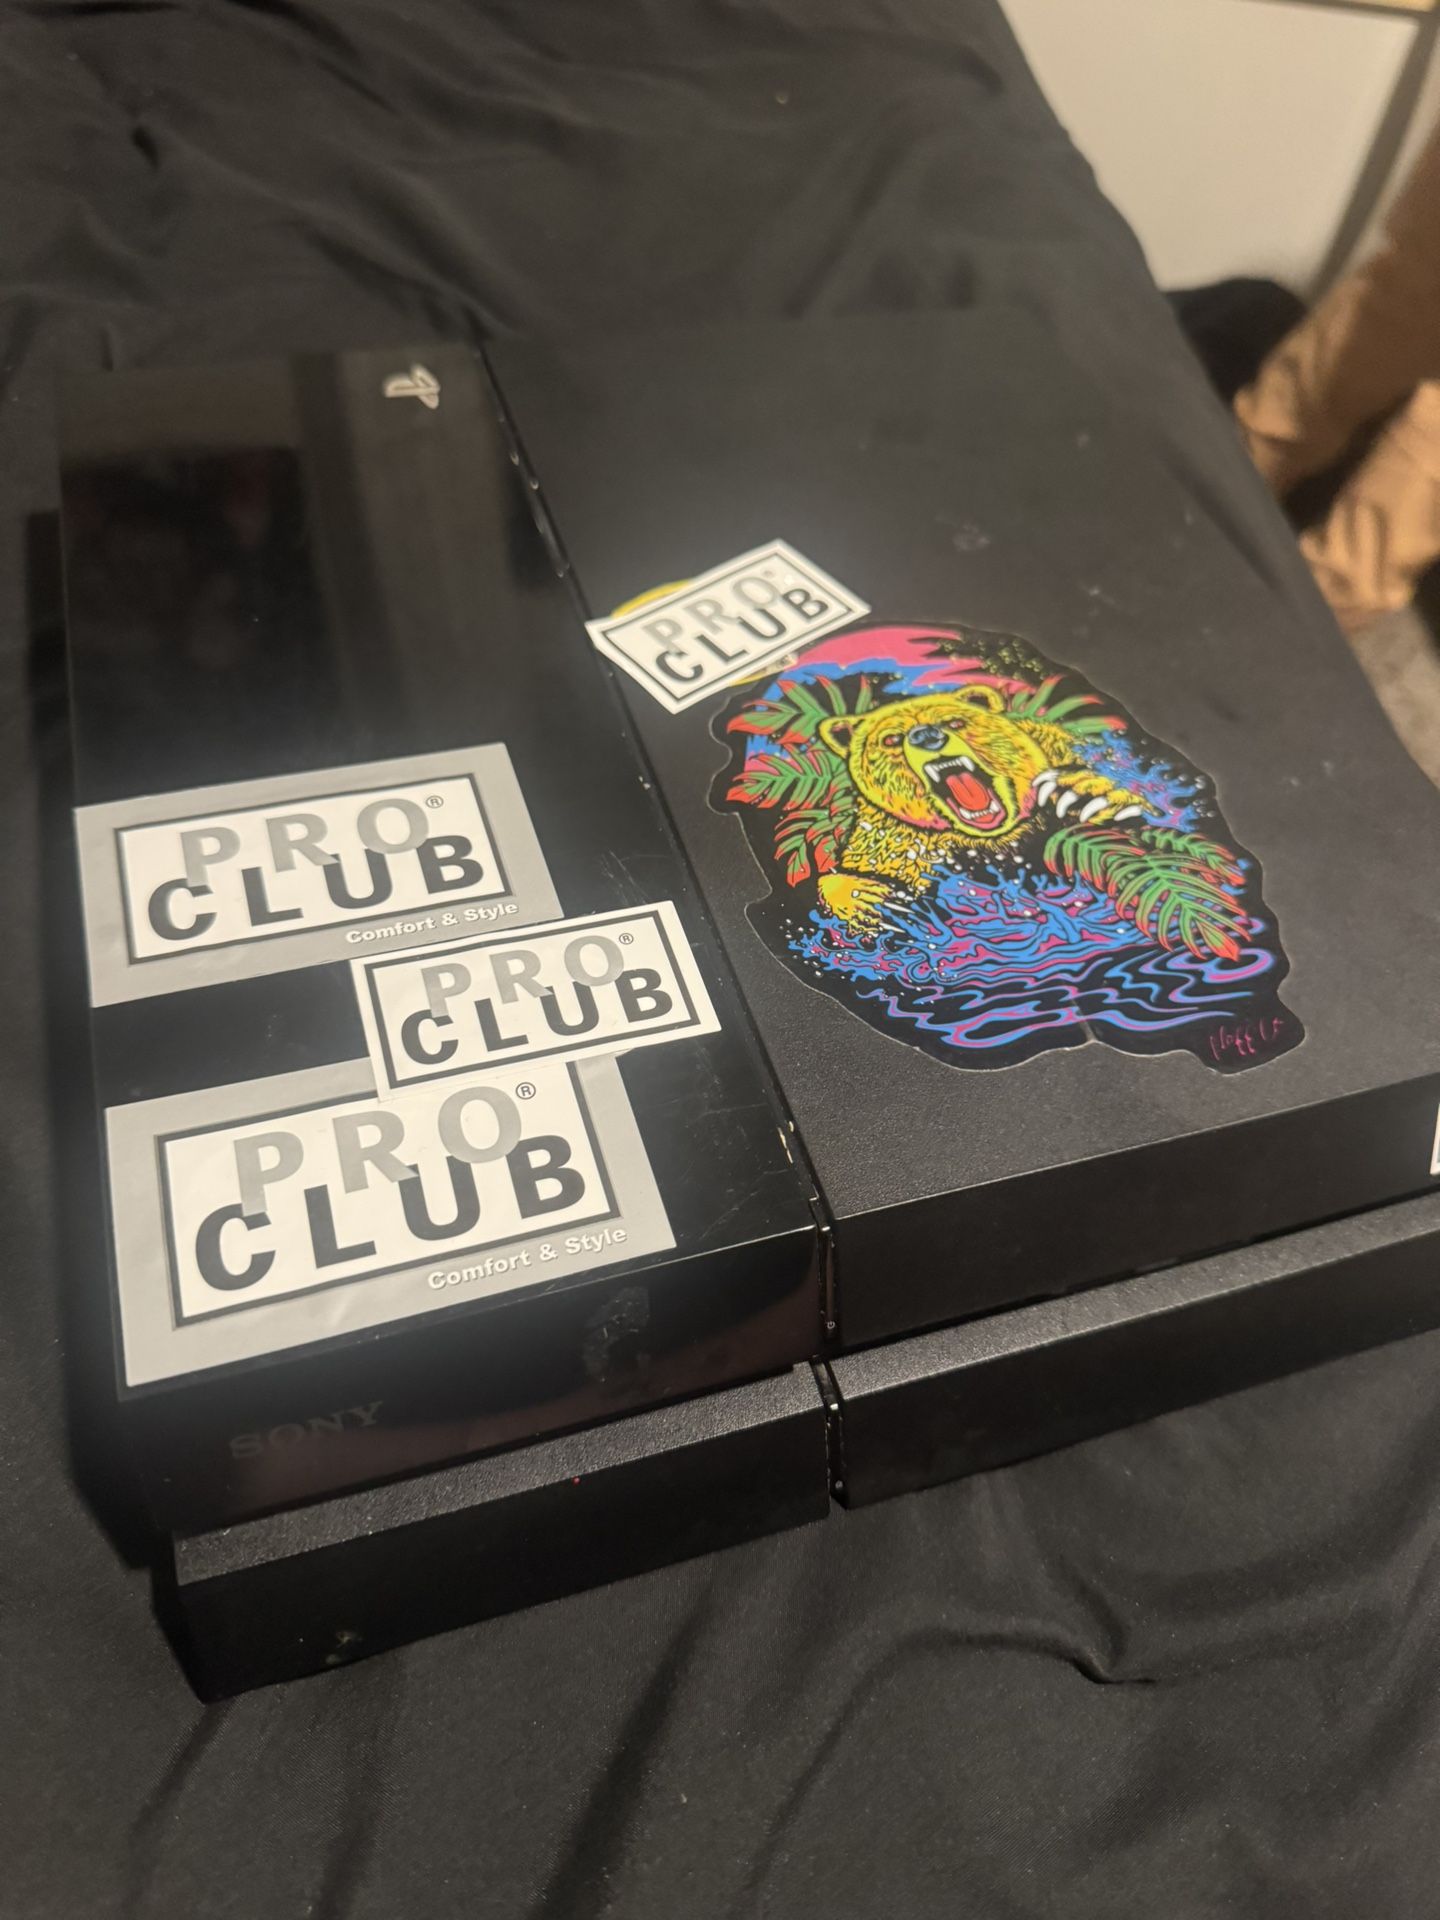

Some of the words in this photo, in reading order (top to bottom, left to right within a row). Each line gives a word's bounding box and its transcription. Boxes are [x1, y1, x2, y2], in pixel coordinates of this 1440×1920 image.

[655, 587, 829, 682] CLUB
[148, 834, 485, 941] CLUB
[345, 917, 436, 944] Comfort
[442, 912, 459, 927] &
[464, 903, 519, 924] Style
[400, 967, 673, 1065] CLUB
[194, 1134, 586, 1291] CLUB
[427, 1248, 532, 1290] Comfort
[539, 1243, 558, 1262] &
[564, 1227, 628, 1254] Style
[229, 1401, 384, 1460] SONY
